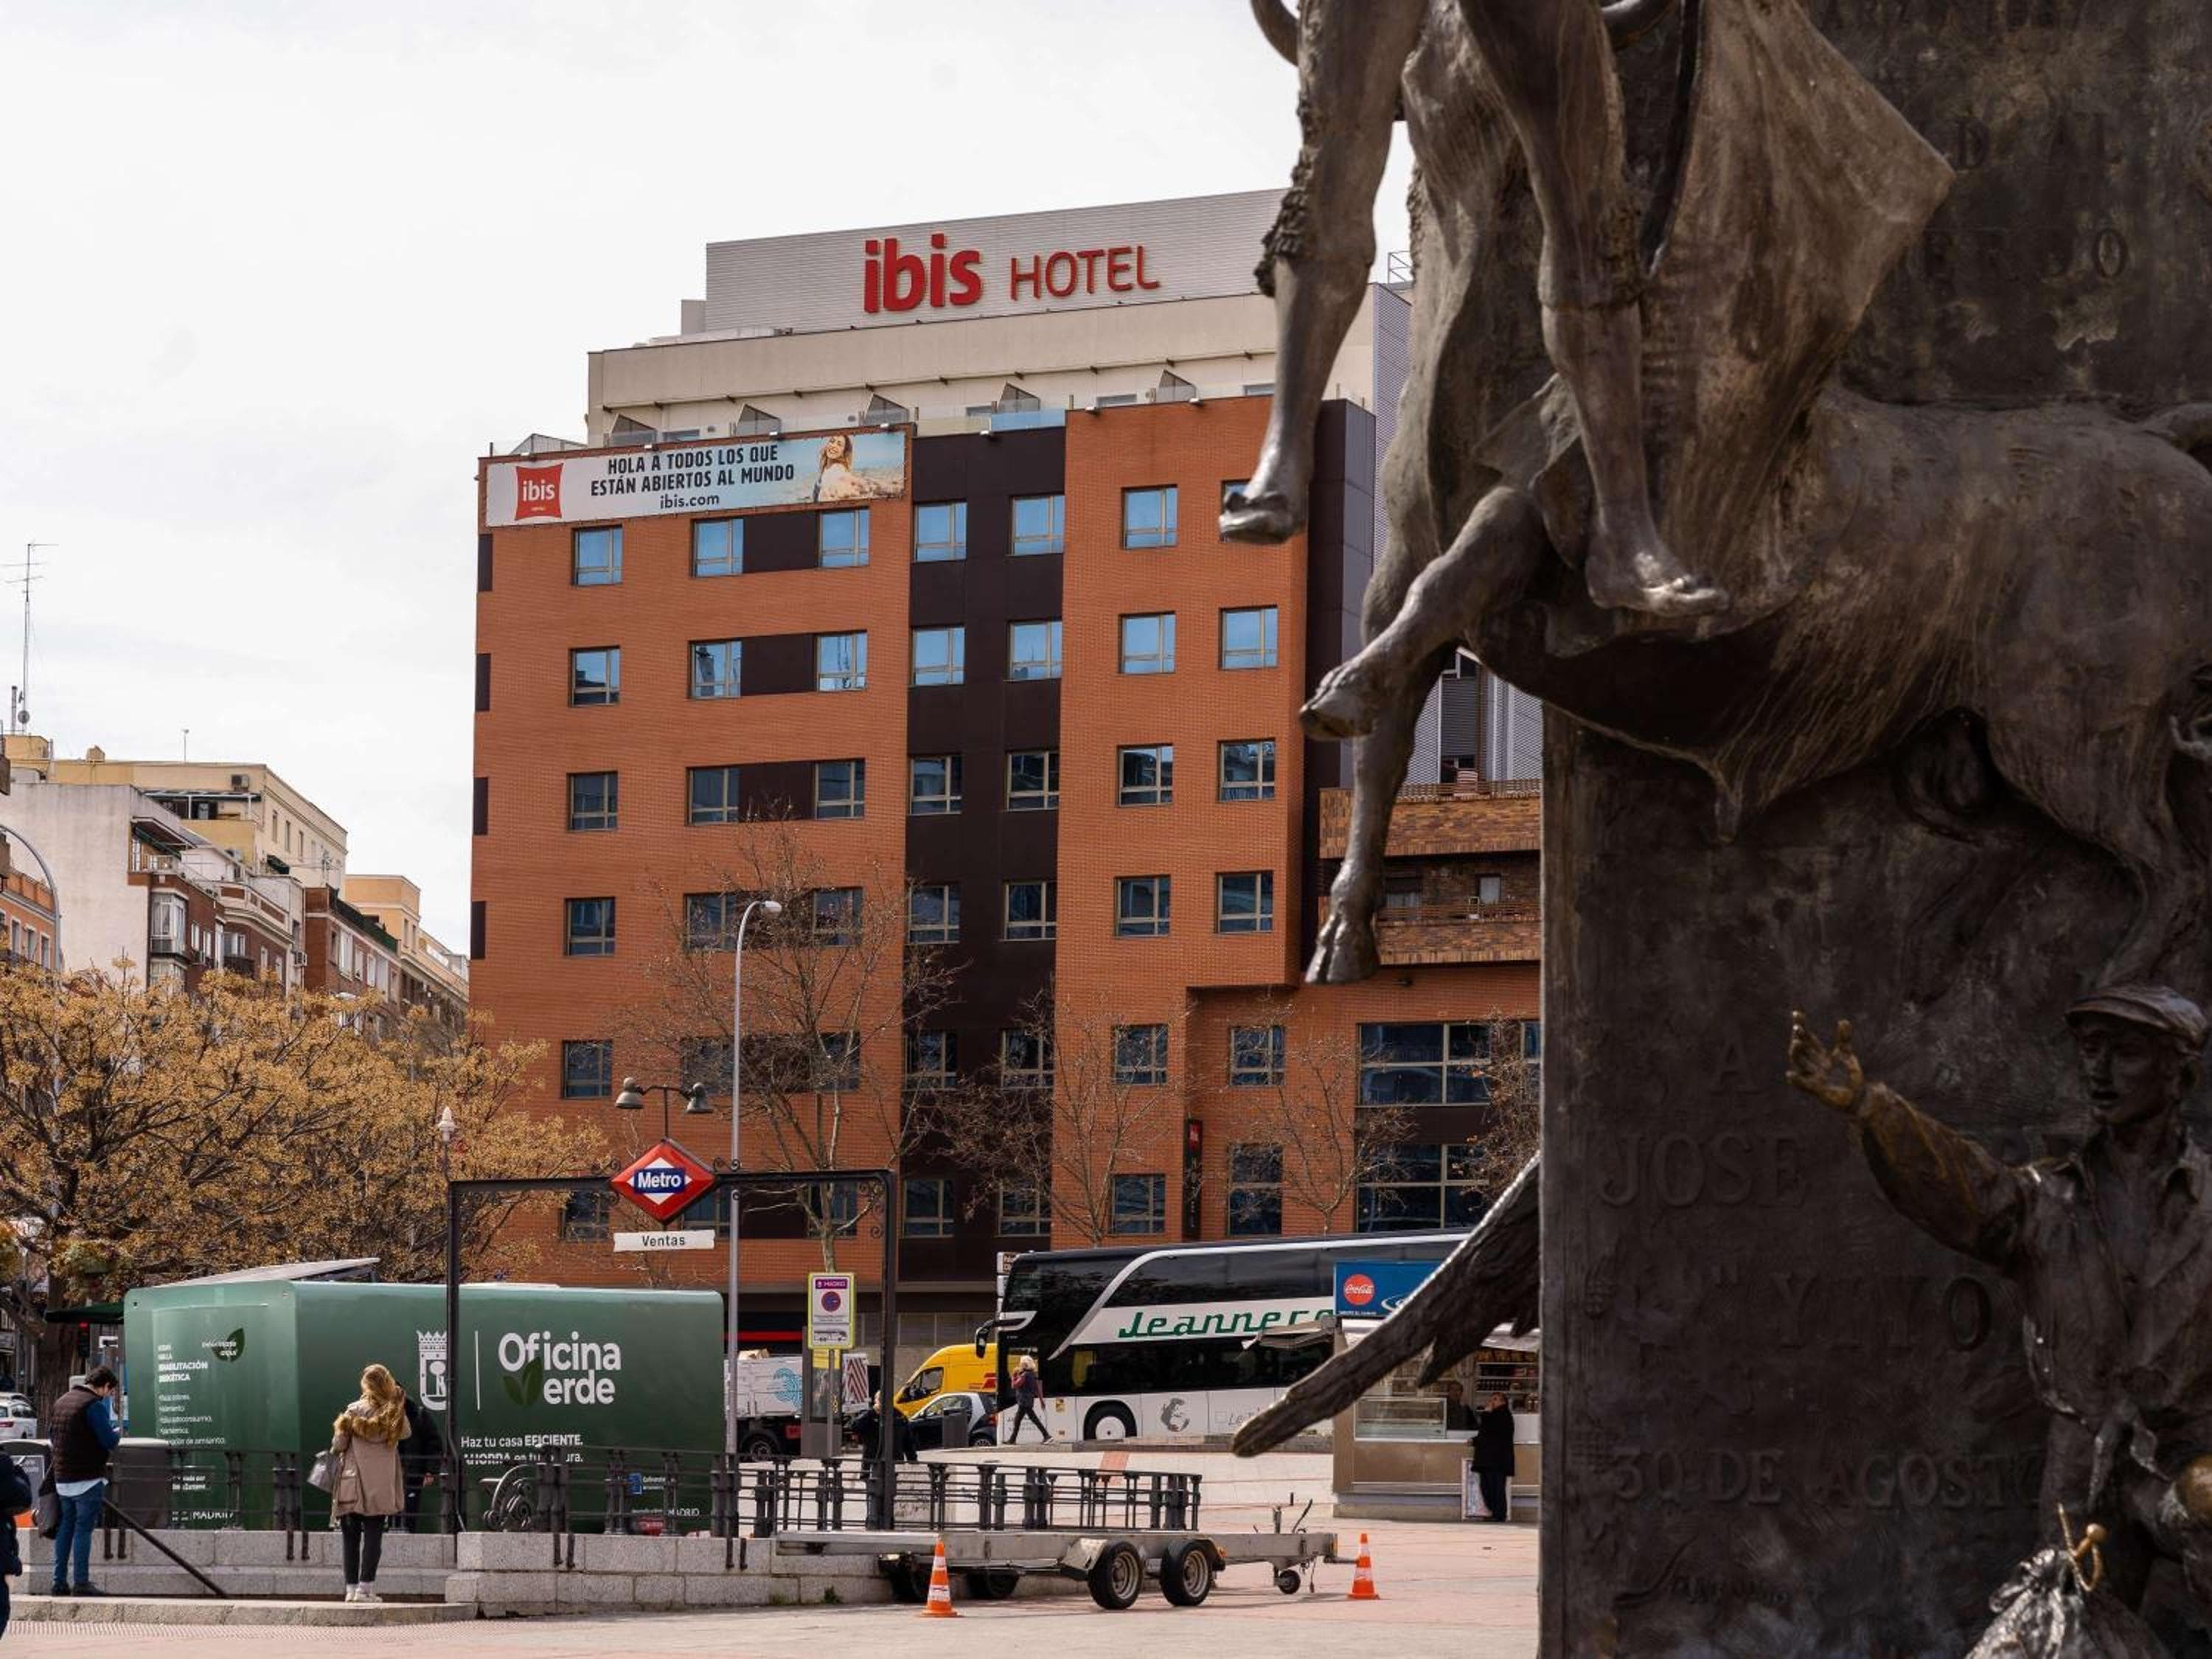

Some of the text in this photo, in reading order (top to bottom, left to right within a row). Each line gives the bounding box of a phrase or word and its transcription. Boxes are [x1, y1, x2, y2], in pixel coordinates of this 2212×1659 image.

[863, 232, 1162, 313] ibis HOTEL
[608, 444, 779, 474] HOLA A TODOS LOS QUE
[522, 479, 556, 501] ibis
[590, 465, 794, 496] ESTÁN ABIERTOS AL MUNDO
[660, 493, 720, 510] ibis.com
[638, 1172, 681, 1189] Metro
[642, 1235, 686, 1247] Ventas
[498, 1331, 622, 1371] Oficina
[461, 1434, 583, 1447] Haz tu casa EFICIENTE.
